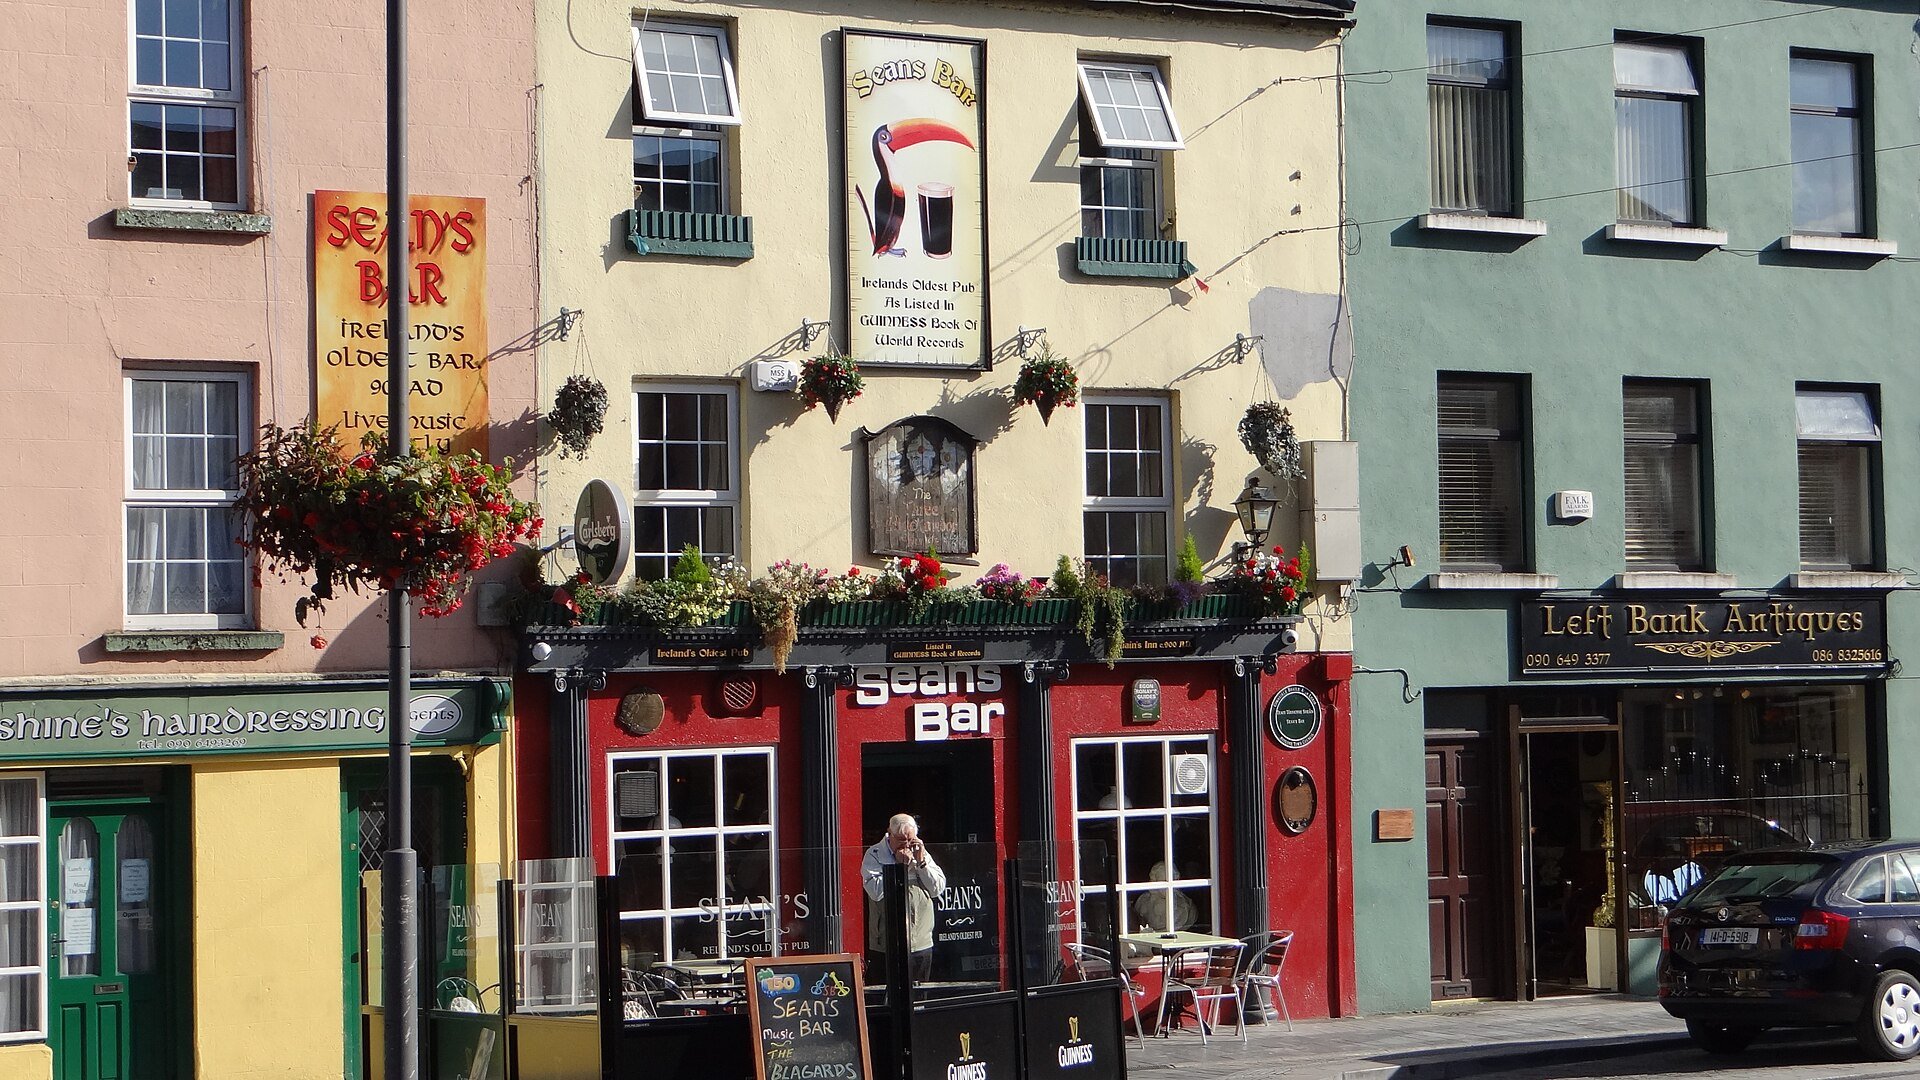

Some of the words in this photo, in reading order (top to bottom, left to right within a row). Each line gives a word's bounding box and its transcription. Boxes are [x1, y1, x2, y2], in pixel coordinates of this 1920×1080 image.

[852, 59, 926, 98] Seans
[931, 58, 977, 107] Bar
[327, 205, 473, 254] SEN'S
[355, 260, 447, 308] BR
[861, 276, 909, 290] Irelands
[912, 279, 948, 292] Oldest
[952, 280, 975, 293] Pub
[884, 296, 901, 309] As
[904, 297, 940, 311] Listed
[944, 299, 954, 311] In
[341, 318, 464, 341] IRELND'S
[860, 315, 927, 329] GUINNESS
[931, 317, 960, 330] Book
[964, 319, 978, 331] Of
[875, 334, 913, 347] World
[917, 335, 965, 349] Records
[327, 346, 418, 368] OLDET
[1321, 513, 1327, 522] 3
[579, 517, 616, 545] Carlsberg
[1543, 604, 1613, 639] Left
[1628, 604, 1710, 634] Bank
[1723, 603, 1864, 641] Antiques
[657, 648, 697, 658] Ireland's
[698, 648, 728, 658] Oldest
[731, 647, 749, 657] Pub
[1144, 640, 1158, 649] Inn
[893, 651, 930, 659] GUINNESS
[1526, 653, 1550, 667] 090
[1556, 653, 1579, 666] 649
[1584, 653, 1611, 666] 3377
[1812, 649, 1834, 662] 086
[1838, 649, 1882, 661] 8325616
[856, 664, 1002, 705] Seans
[914, 702, 1005, 741] Bar
[166, 739, 192, 750] 090
[195, 737, 248, 749] 6493269
[937, 884, 983, 912] SEAN'S
[122, 911, 139, 919] Open
[698, 892, 810, 924] SEAN'S
[974, 930, 983, 939] PUB
[1709, 931, 1750, 943] 141-D-5918
[702, 944, 750, 955] RELND'S
[751, 942, 789, 952] OLDST
[791, 941, 810, 950] PUB
[763, 1028, 795, 1040] Music
[799, 1019, 835, 1037] BAR
[767, 1048, 795, 1060] THE
[1058, 1044, 1093, 1068] GUINNESS
[770, 1062, 858, 1080] BLAGARDS
[947, 1061, 987, 1080] GUINNESS
